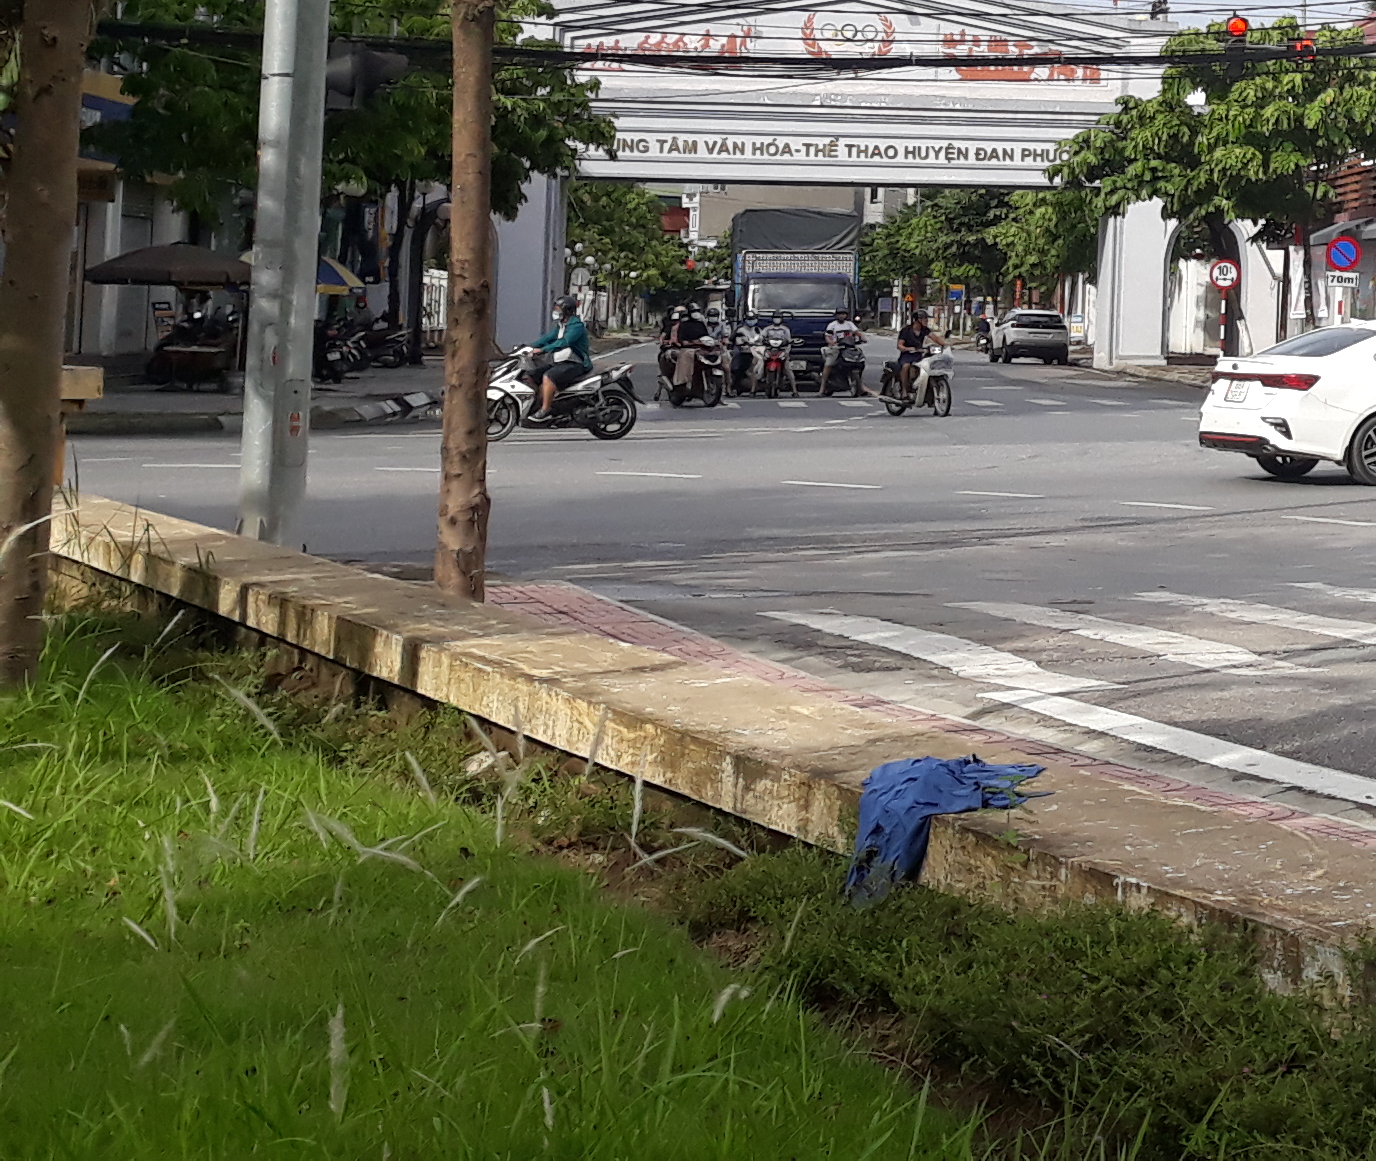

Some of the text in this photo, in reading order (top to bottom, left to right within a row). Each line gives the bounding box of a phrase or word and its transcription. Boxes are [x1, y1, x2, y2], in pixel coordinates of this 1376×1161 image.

[656, 136, 698, 155] TÂM
[704, 136, 746, 157] VĂN
[844, 143, 899, 161] THAO
[904, 142, 970, 164] HUYỆN
[974, 146, 1015, 163] ĐAN
[1330, 274, 1354, 284] 70m
